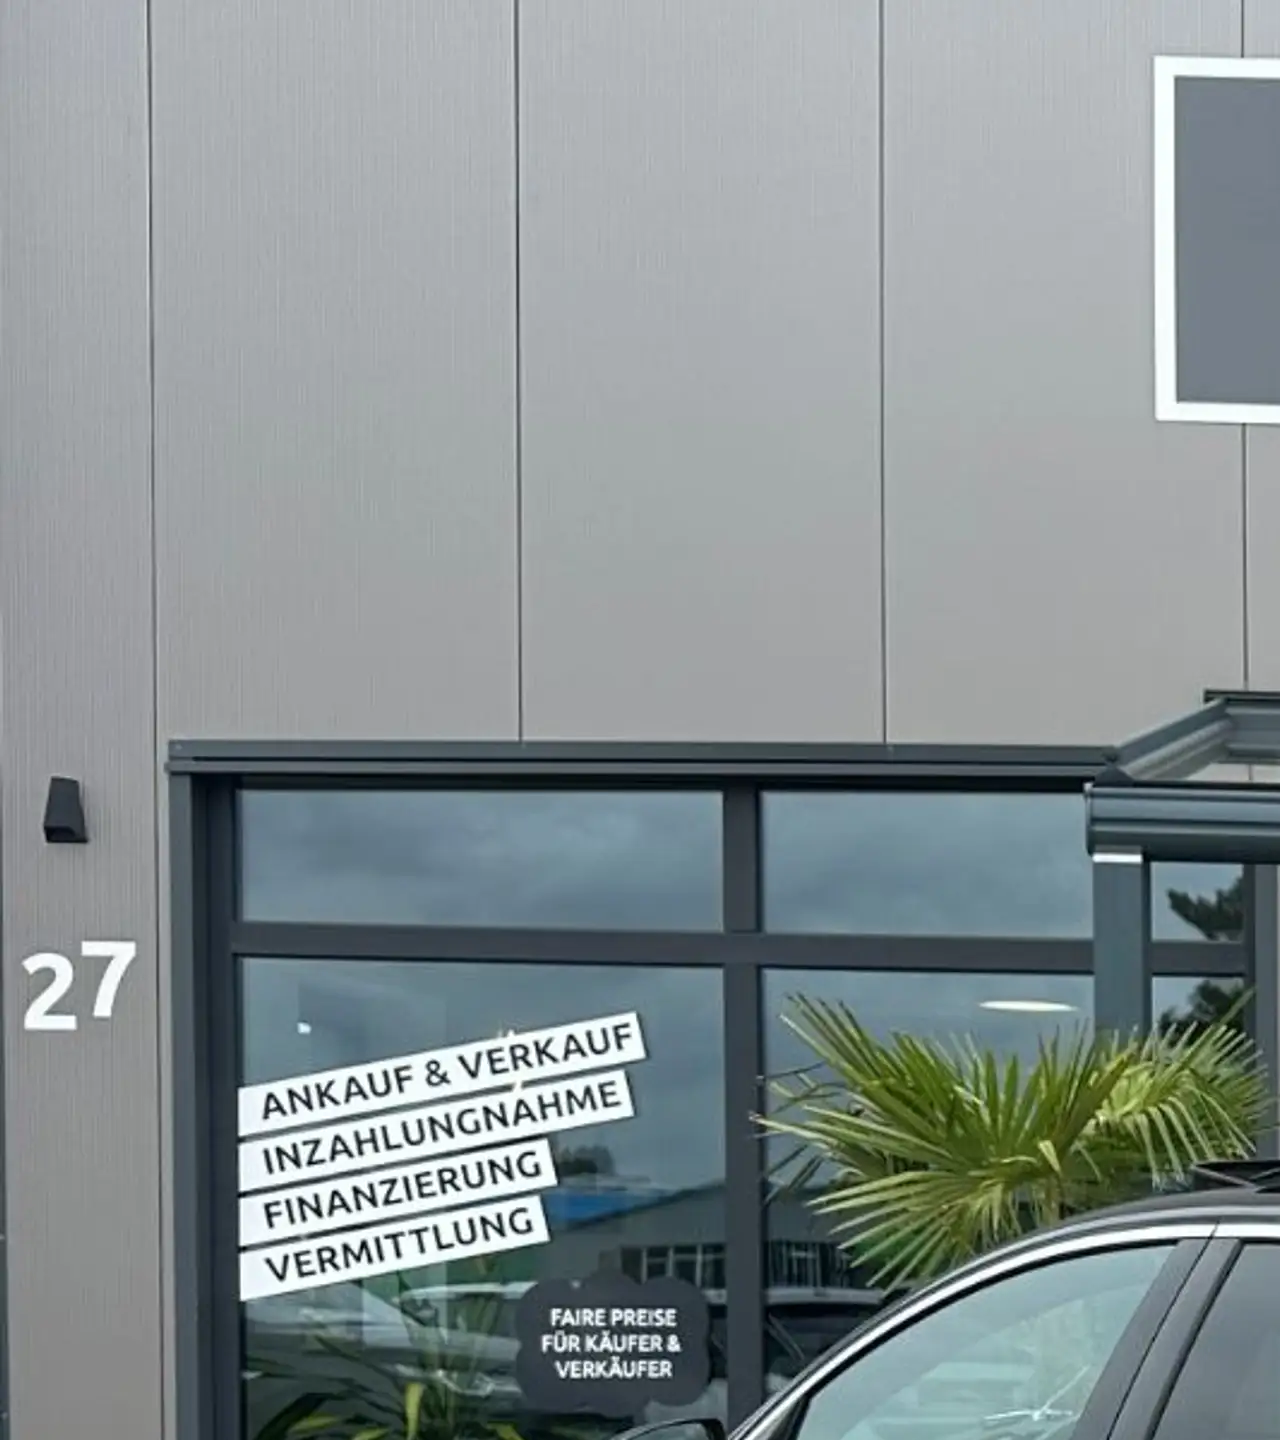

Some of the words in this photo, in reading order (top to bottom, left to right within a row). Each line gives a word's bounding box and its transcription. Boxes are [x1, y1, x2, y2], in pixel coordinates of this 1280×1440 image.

[22, 940, 136, 1031] 27
[261, 1065, 413, 1120] ANKAUF
[424, 1059, 450, 1088] &
[457, 1022, 633, 1080] VERKAUF
[262, 1080, 622, 1175] INZAHLUNGNAHME
[263, 1150, 542, 1229] FINANZIERUNG
[265, 1207, 534, 1283] VERMITTLUNG
[541, 1330, 580, 1353] FÜR
[585, 1330, 663, 1353] KÄUFER
[666, 1334, 681, 1352] &
[551, 1307, 607, 1326] FAIRE
[611, 1307, 677, 1327] PREISE
[554, 1356, 673, 1379] VERKÄUFER
